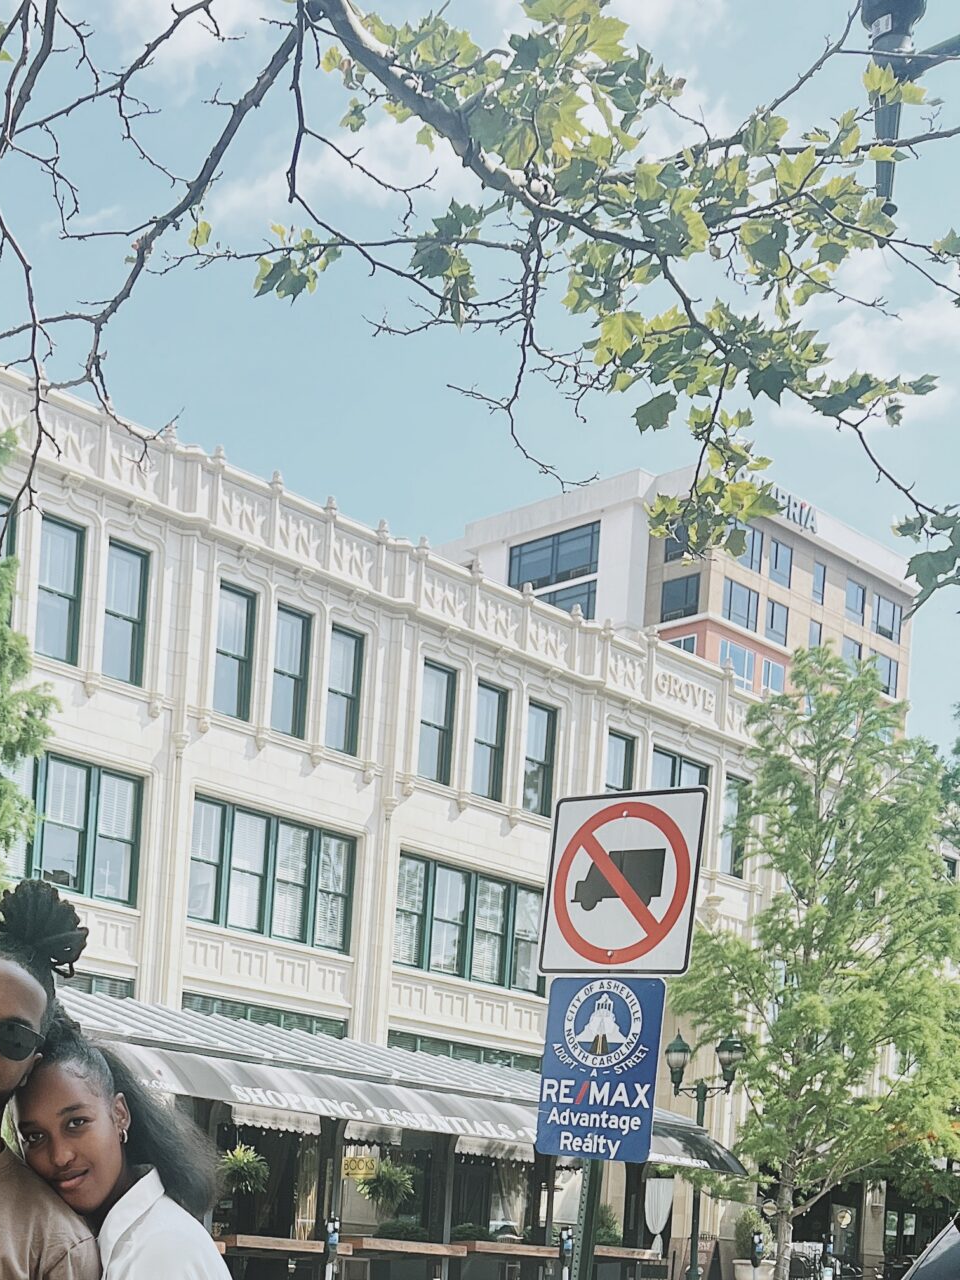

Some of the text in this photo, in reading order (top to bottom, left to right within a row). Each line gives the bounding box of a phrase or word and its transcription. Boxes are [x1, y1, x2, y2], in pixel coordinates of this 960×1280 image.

[655, 672, 715, 713] GROVE
[567, 981, 641, 1023] CITY OF ASHEVILLE
[552, 1043, 578, 1070] ADOPT
[613, 1044, 649, 1075] STREET
[565, 1028, 640, 1066] NORTH CAROLINA
[542, 1078, 651, 1109] RE/MAX
[230, 1084, 364, 1121] SHOPPING
[373, 1107, 517, 1141] ESSENTIALS
[547, 1107, 642, 1136] Advantage
[560, 1131, 621, 1160] Realty
[343, 1158, 376, 1171] BOOKS
